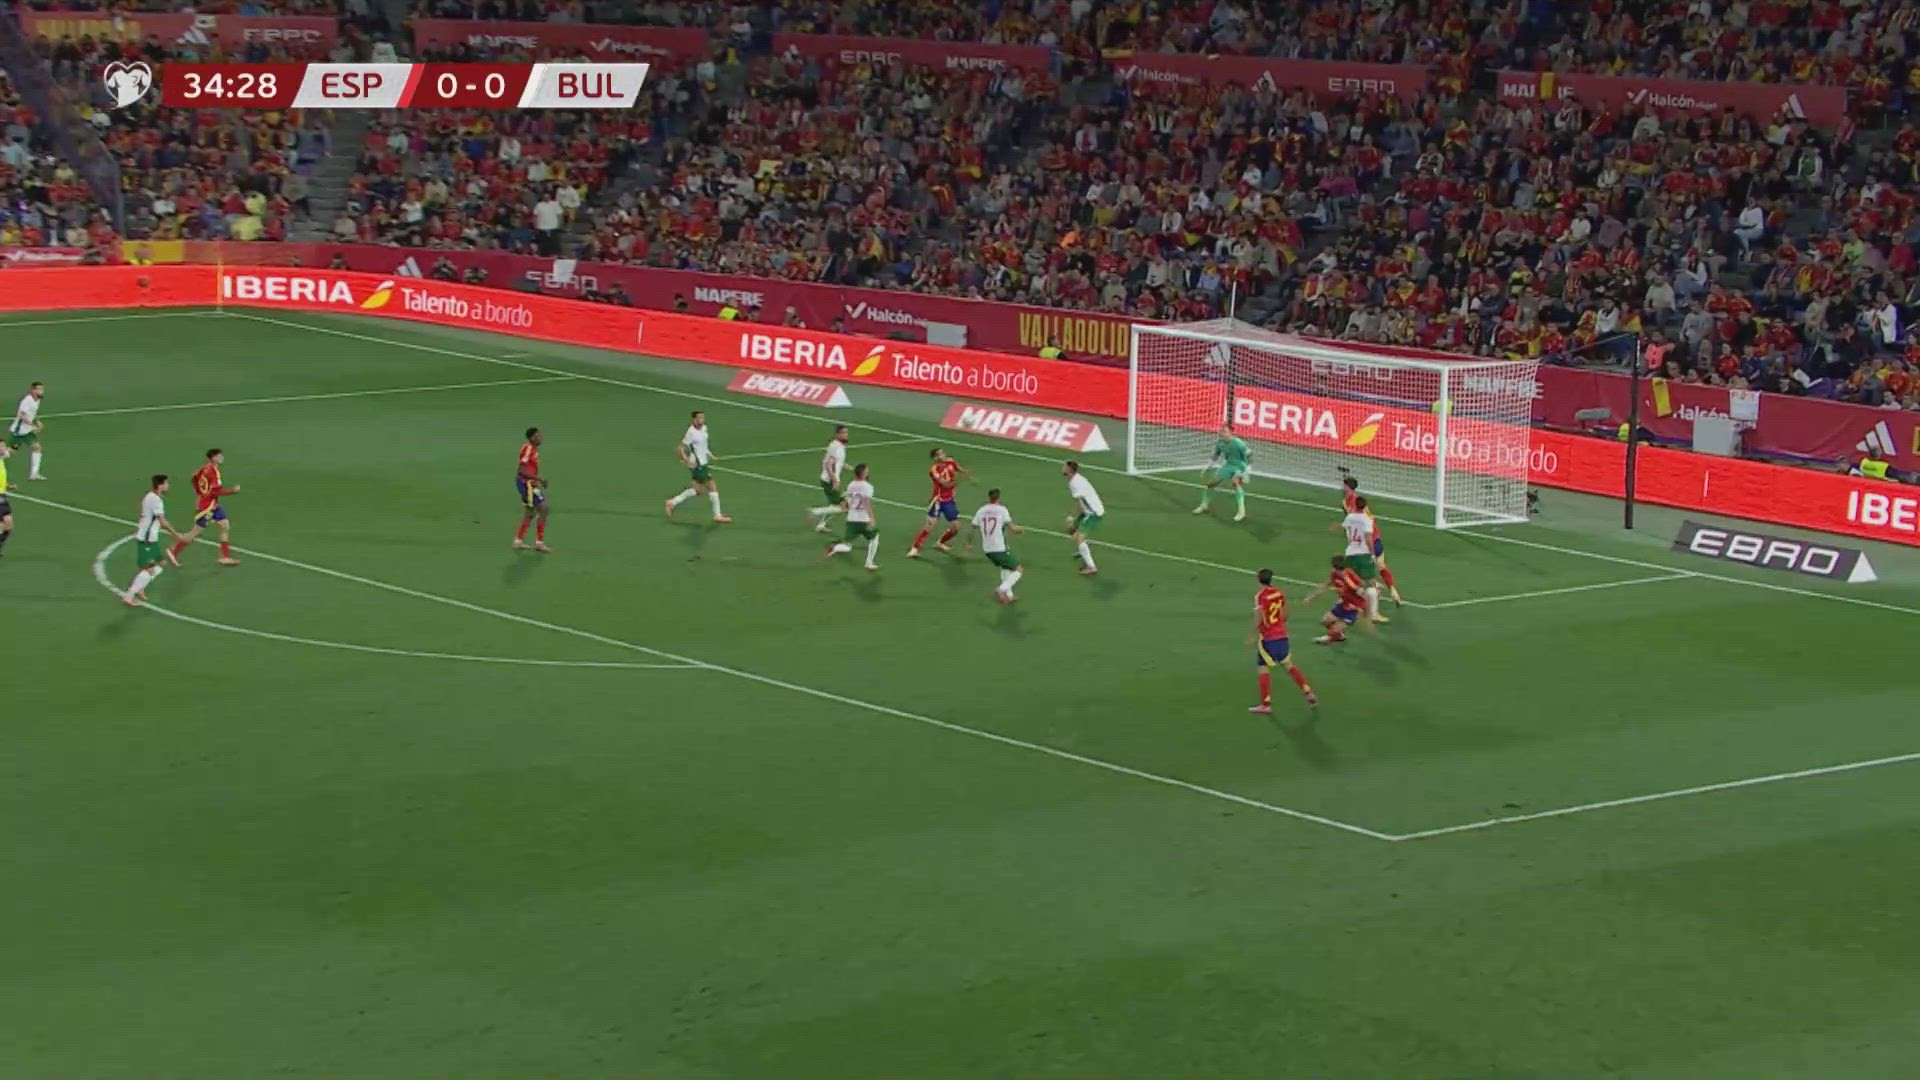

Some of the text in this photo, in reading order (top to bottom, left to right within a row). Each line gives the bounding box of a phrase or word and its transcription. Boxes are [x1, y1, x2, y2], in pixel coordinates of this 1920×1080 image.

[223, 275, 533, 328] IBERIA Talento a bordo
[1019, 311, 1130, 357] VALLADOLID
[740, 333, 1039, 395] IBERIA Talento a bordo
[957, 406, 1080, 446] MAPFRE
[982, 516, 998, 536] 17
[1690, 528, 1840, 575] EBRO
